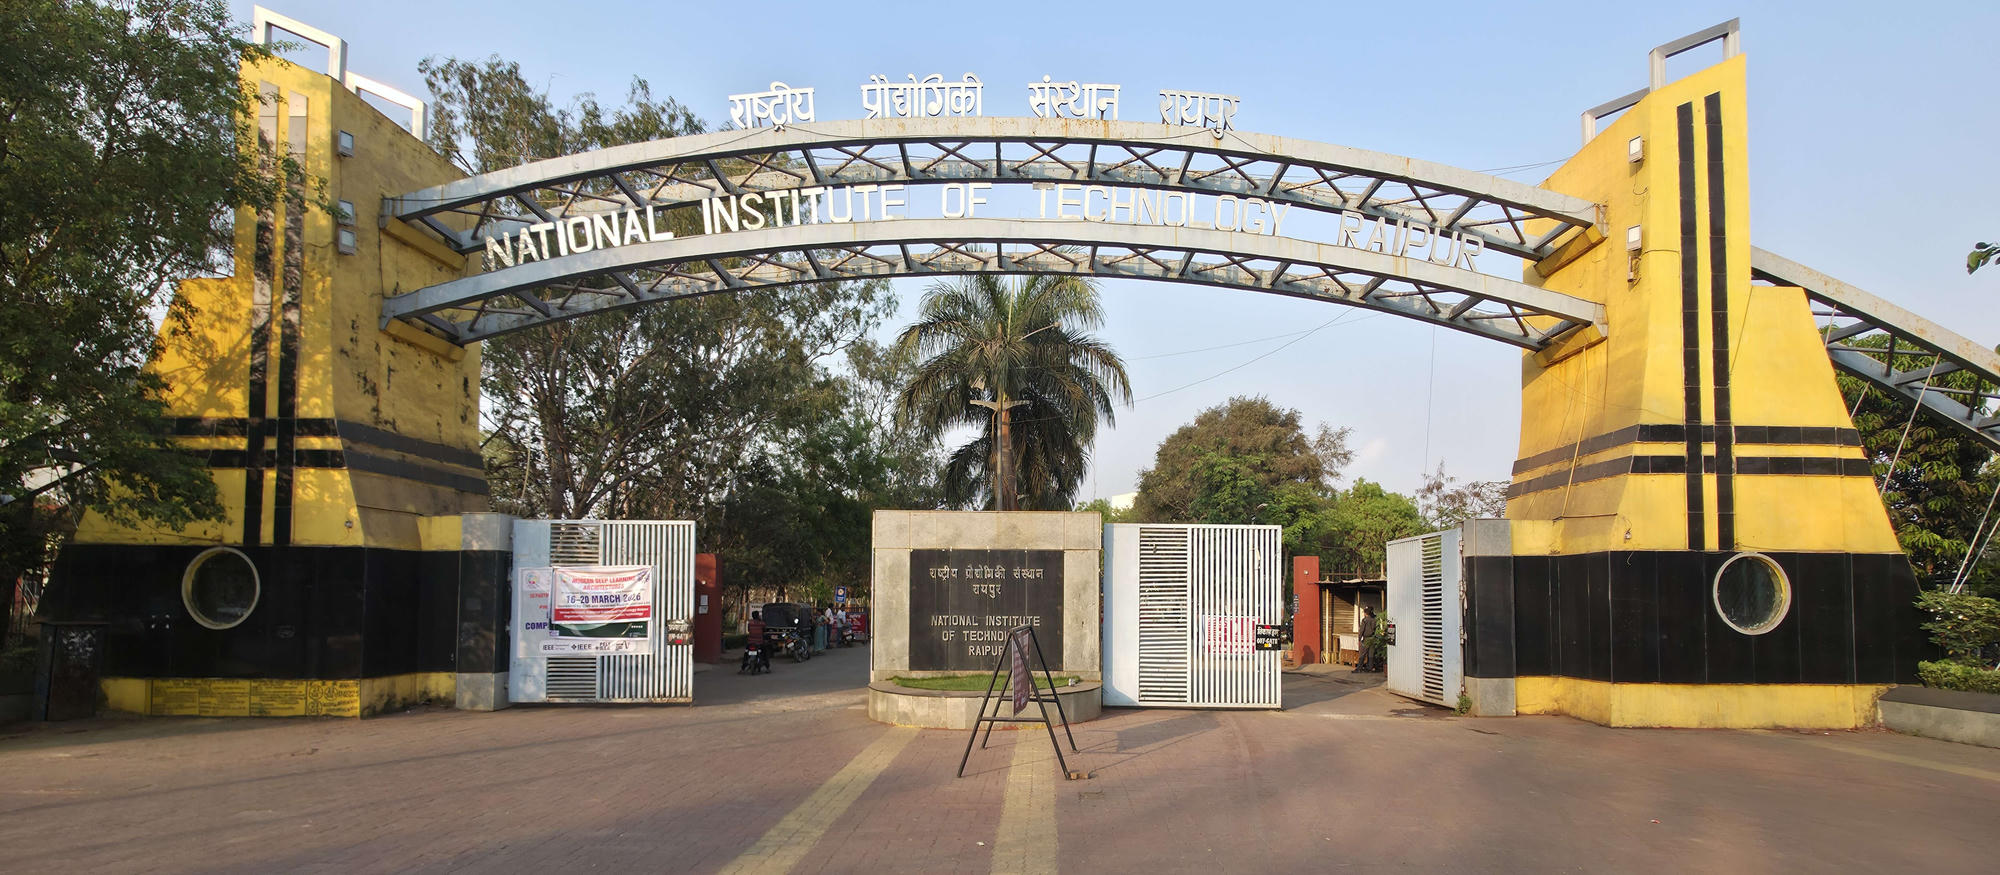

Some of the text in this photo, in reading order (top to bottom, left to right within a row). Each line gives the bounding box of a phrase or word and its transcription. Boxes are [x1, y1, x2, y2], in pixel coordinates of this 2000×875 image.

[728, 73, 1240, 139] राष्ट्रीय प्रौद्योगिकी संस्थान रायपुर
[486, 182, 1484, 272] NATIONAL INSTITUTE OF TECHNOLOGY RAIPUR
[1013, 565, 1044, 580] संस्थान
[591, 594, 621, 604] MARCH
[973, 584, 1002, 599] रायपुर
[931, 615, 1040, 627] NATIONAL INSTITUTE
[942, 631, 955, 641] OF
